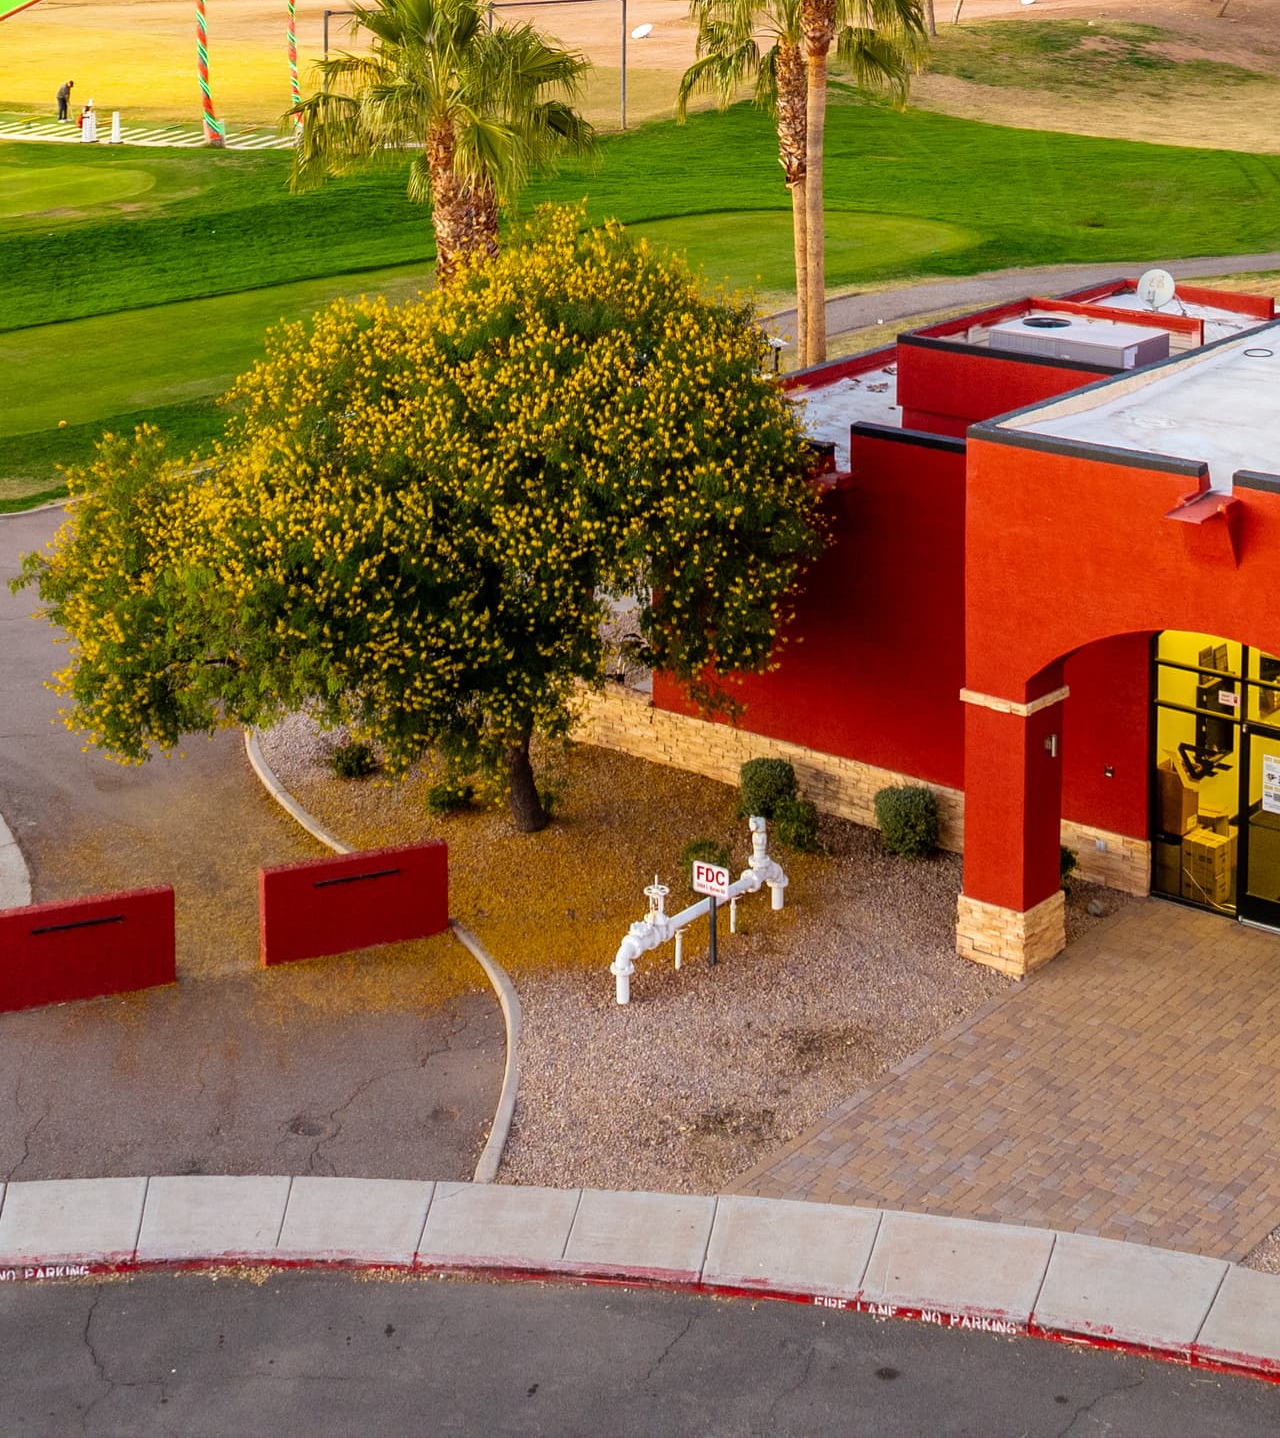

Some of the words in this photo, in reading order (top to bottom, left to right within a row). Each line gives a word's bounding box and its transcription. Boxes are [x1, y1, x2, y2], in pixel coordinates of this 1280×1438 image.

[696, 865, 725, 886] FDC
[24, 1265, 90, 1279] PARKING
[814, 1296, 848, 1309] FIRE
[921, 1309, 941, 1325] NO
[950, 1314, 1017, 1335] PARKING
